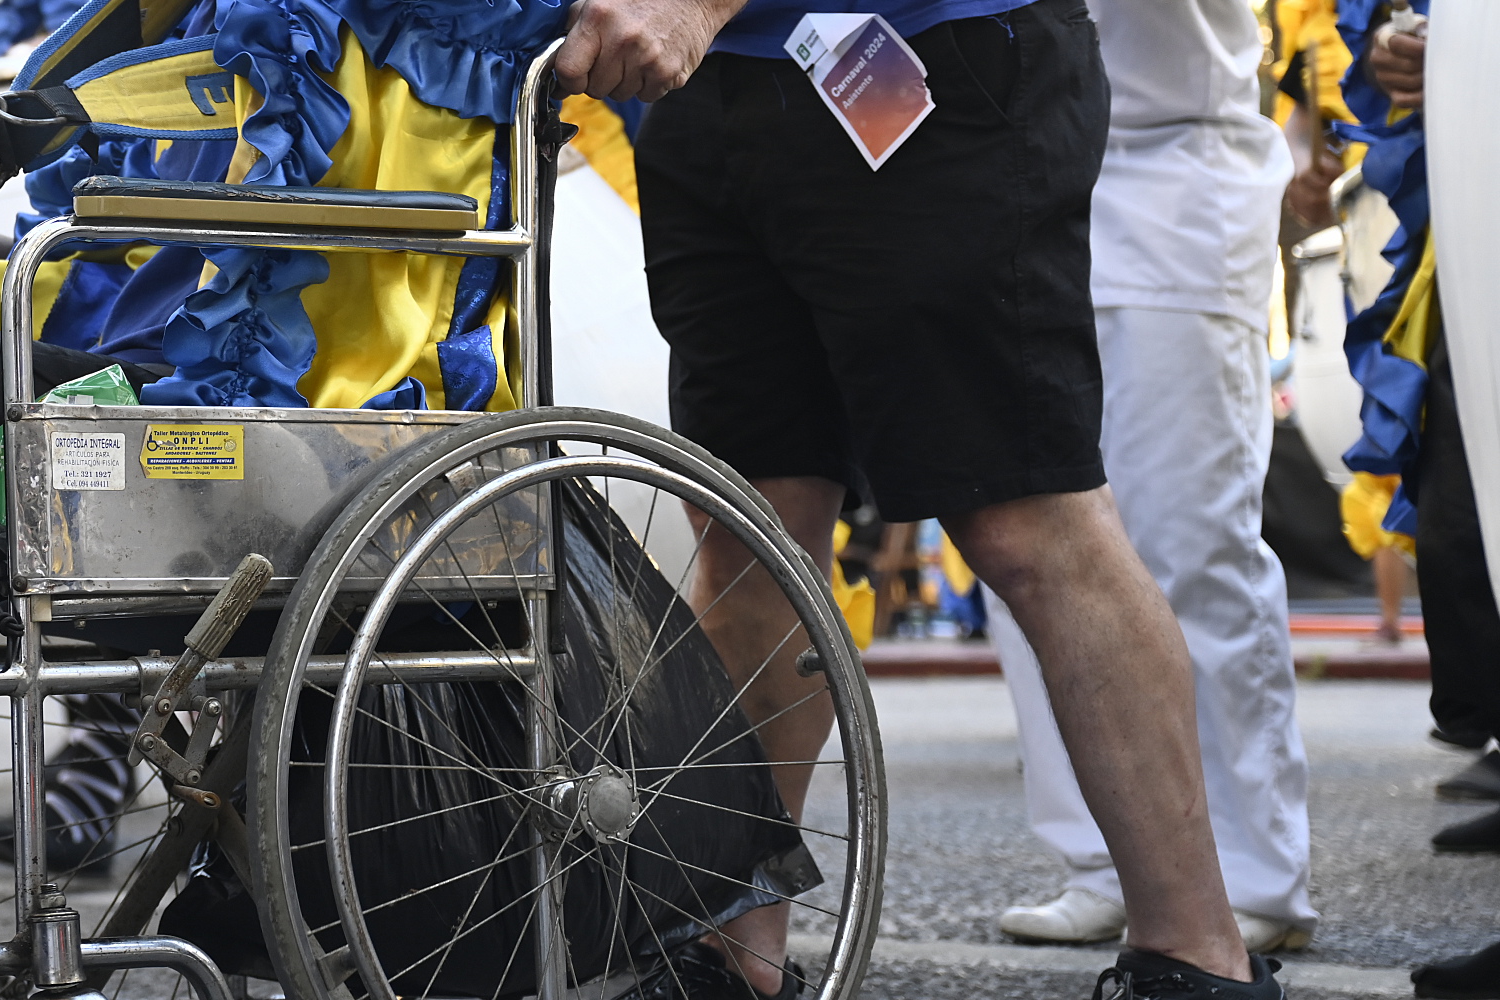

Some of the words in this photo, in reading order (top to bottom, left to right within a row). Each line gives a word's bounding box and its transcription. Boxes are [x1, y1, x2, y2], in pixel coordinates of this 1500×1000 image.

[831, 56, 867, 98] Carnaval
[864, 32, 887, 59] 2024
[842, 74, 874, 110] Asistente
[56, 438, 87, 448] ORTOPEDIA
[90, 438, 120, 448] INTEGRAL
